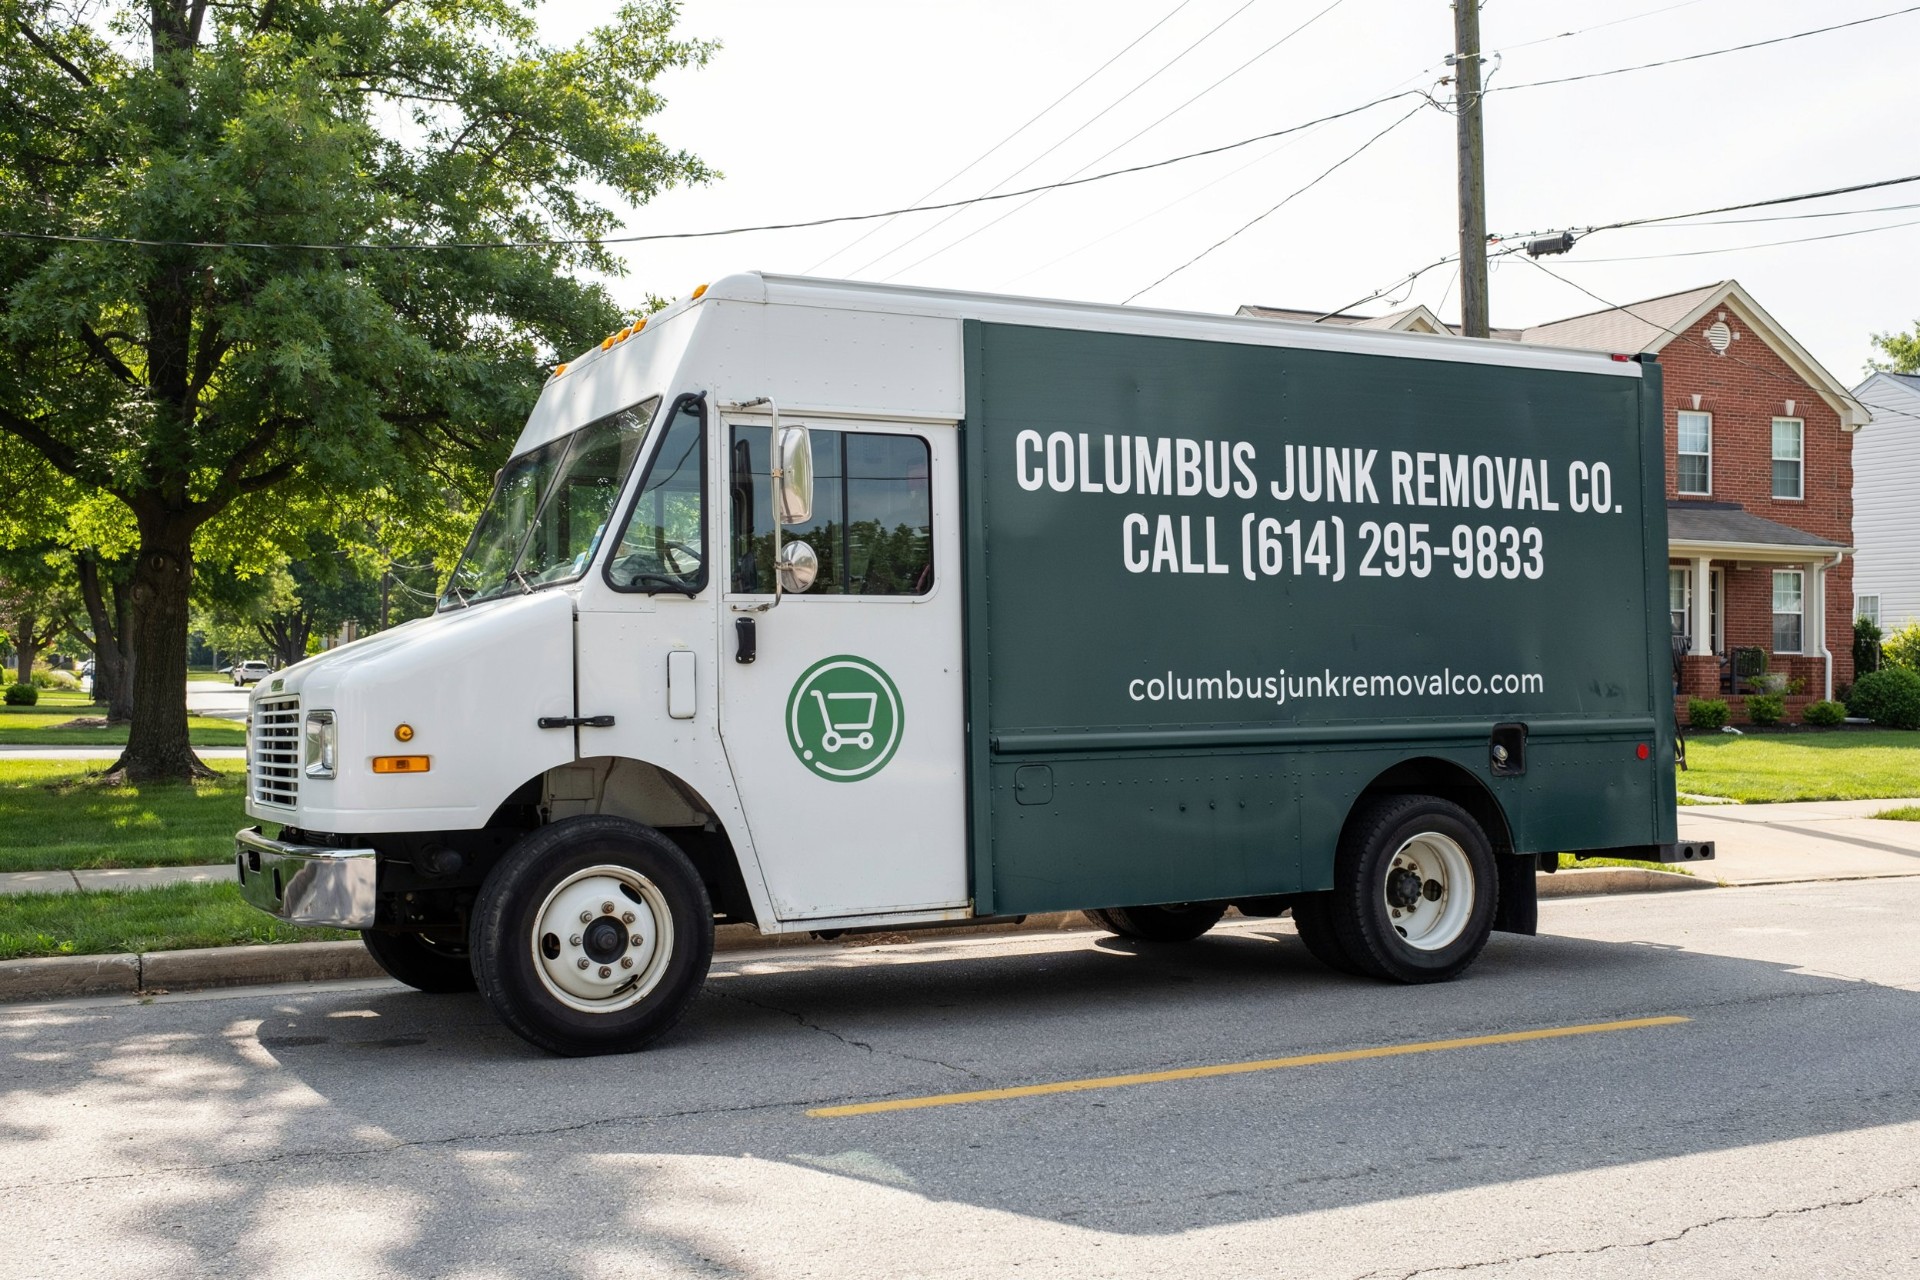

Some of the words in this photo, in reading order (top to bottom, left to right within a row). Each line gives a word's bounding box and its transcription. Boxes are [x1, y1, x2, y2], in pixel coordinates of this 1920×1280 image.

[1015, 429, 1259, 500] COLUMBUS
[1270, 444, 1380, 505] JUNK
[1391, 450, 1560, 512] REMOVAL
[1568, 460, 1623, 515] CO.
[1122, 512, 1229, 575] CALL
[1241, 512, 1346, 582] (614)
[1358, 521, 1544, 580] 295-9833
[1128, 667, 1544, 706] columbusjunkremovalco.com
